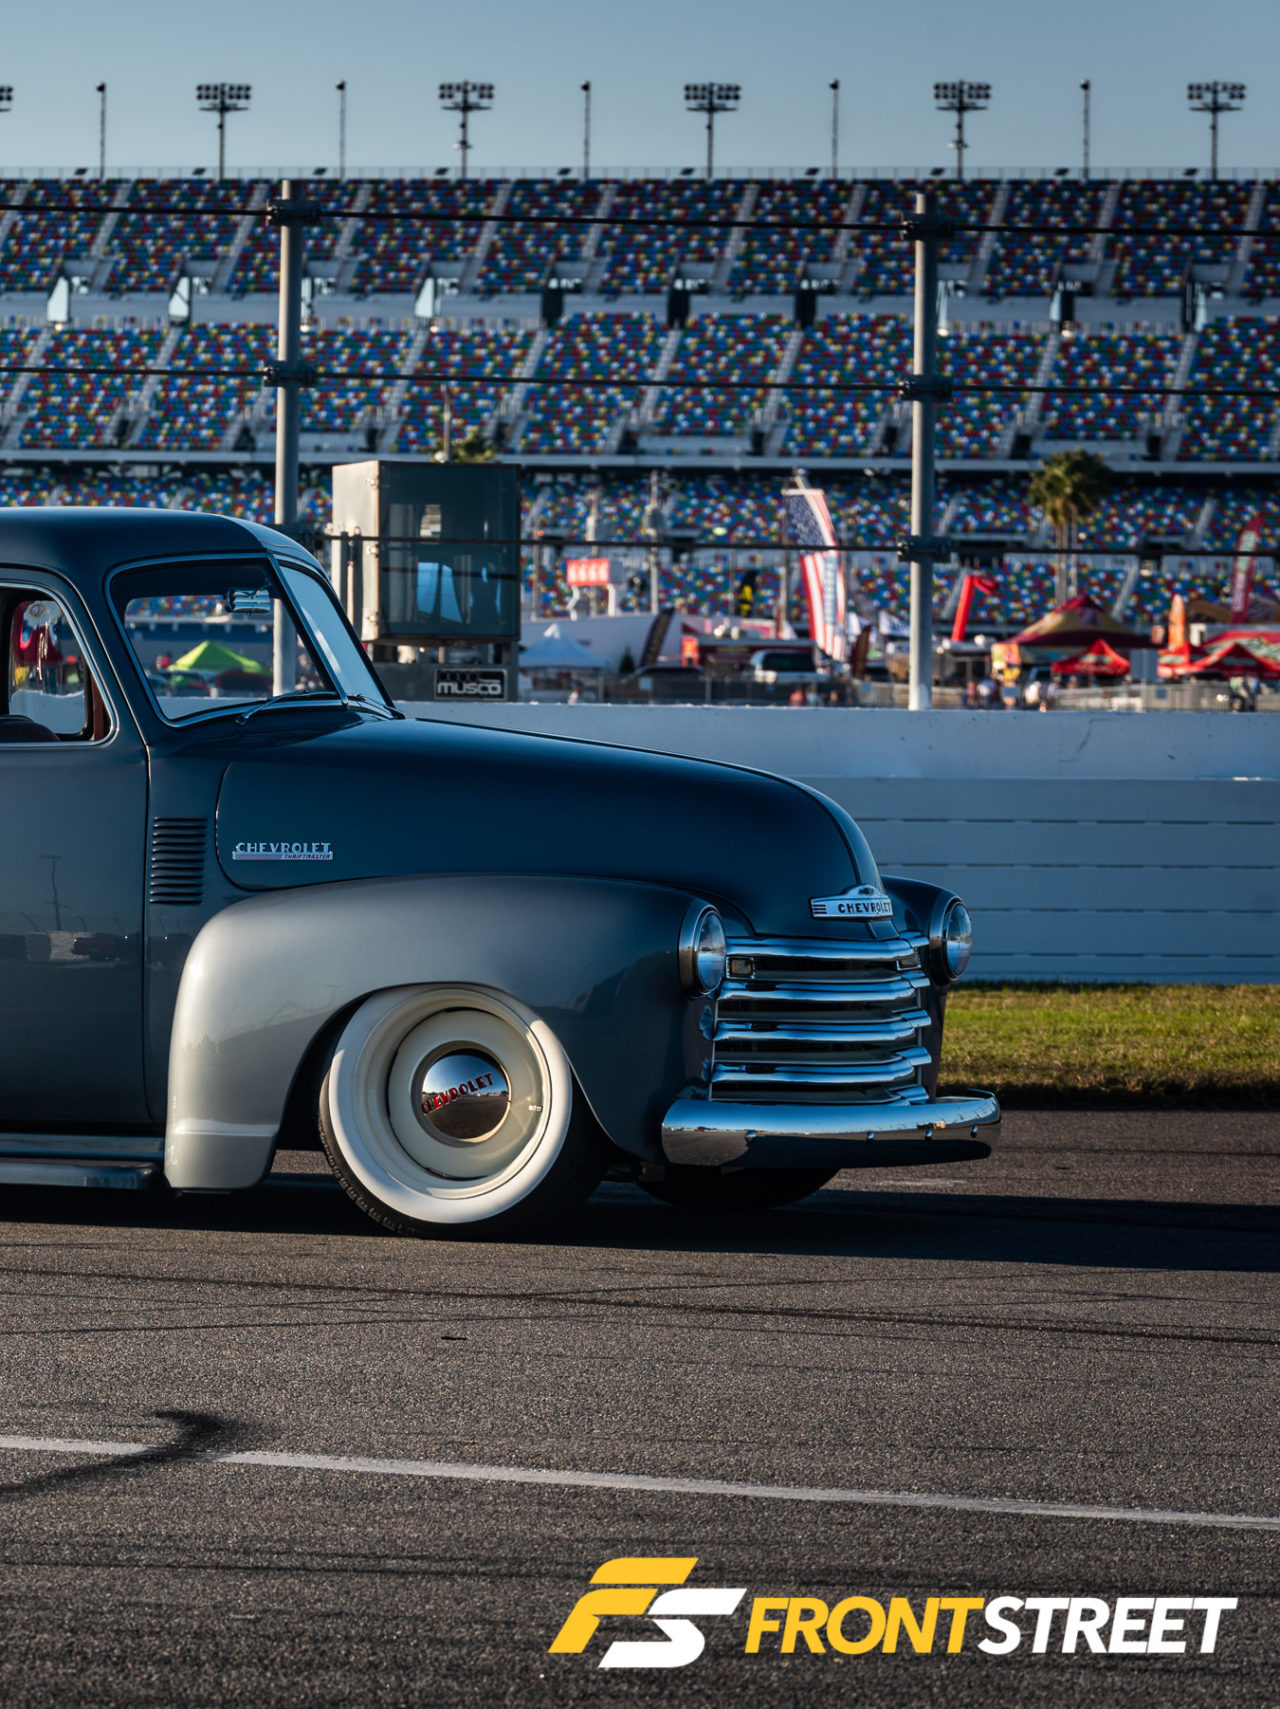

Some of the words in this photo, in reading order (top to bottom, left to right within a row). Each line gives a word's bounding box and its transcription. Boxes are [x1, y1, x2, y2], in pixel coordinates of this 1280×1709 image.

[437, 682, 502, 695] musco
[236, 842, 331, 853] CHEVROLET
[837, 902, 892, 914] CHEVROLET
[421, 1073, 493, 1115] CHEVROLET
